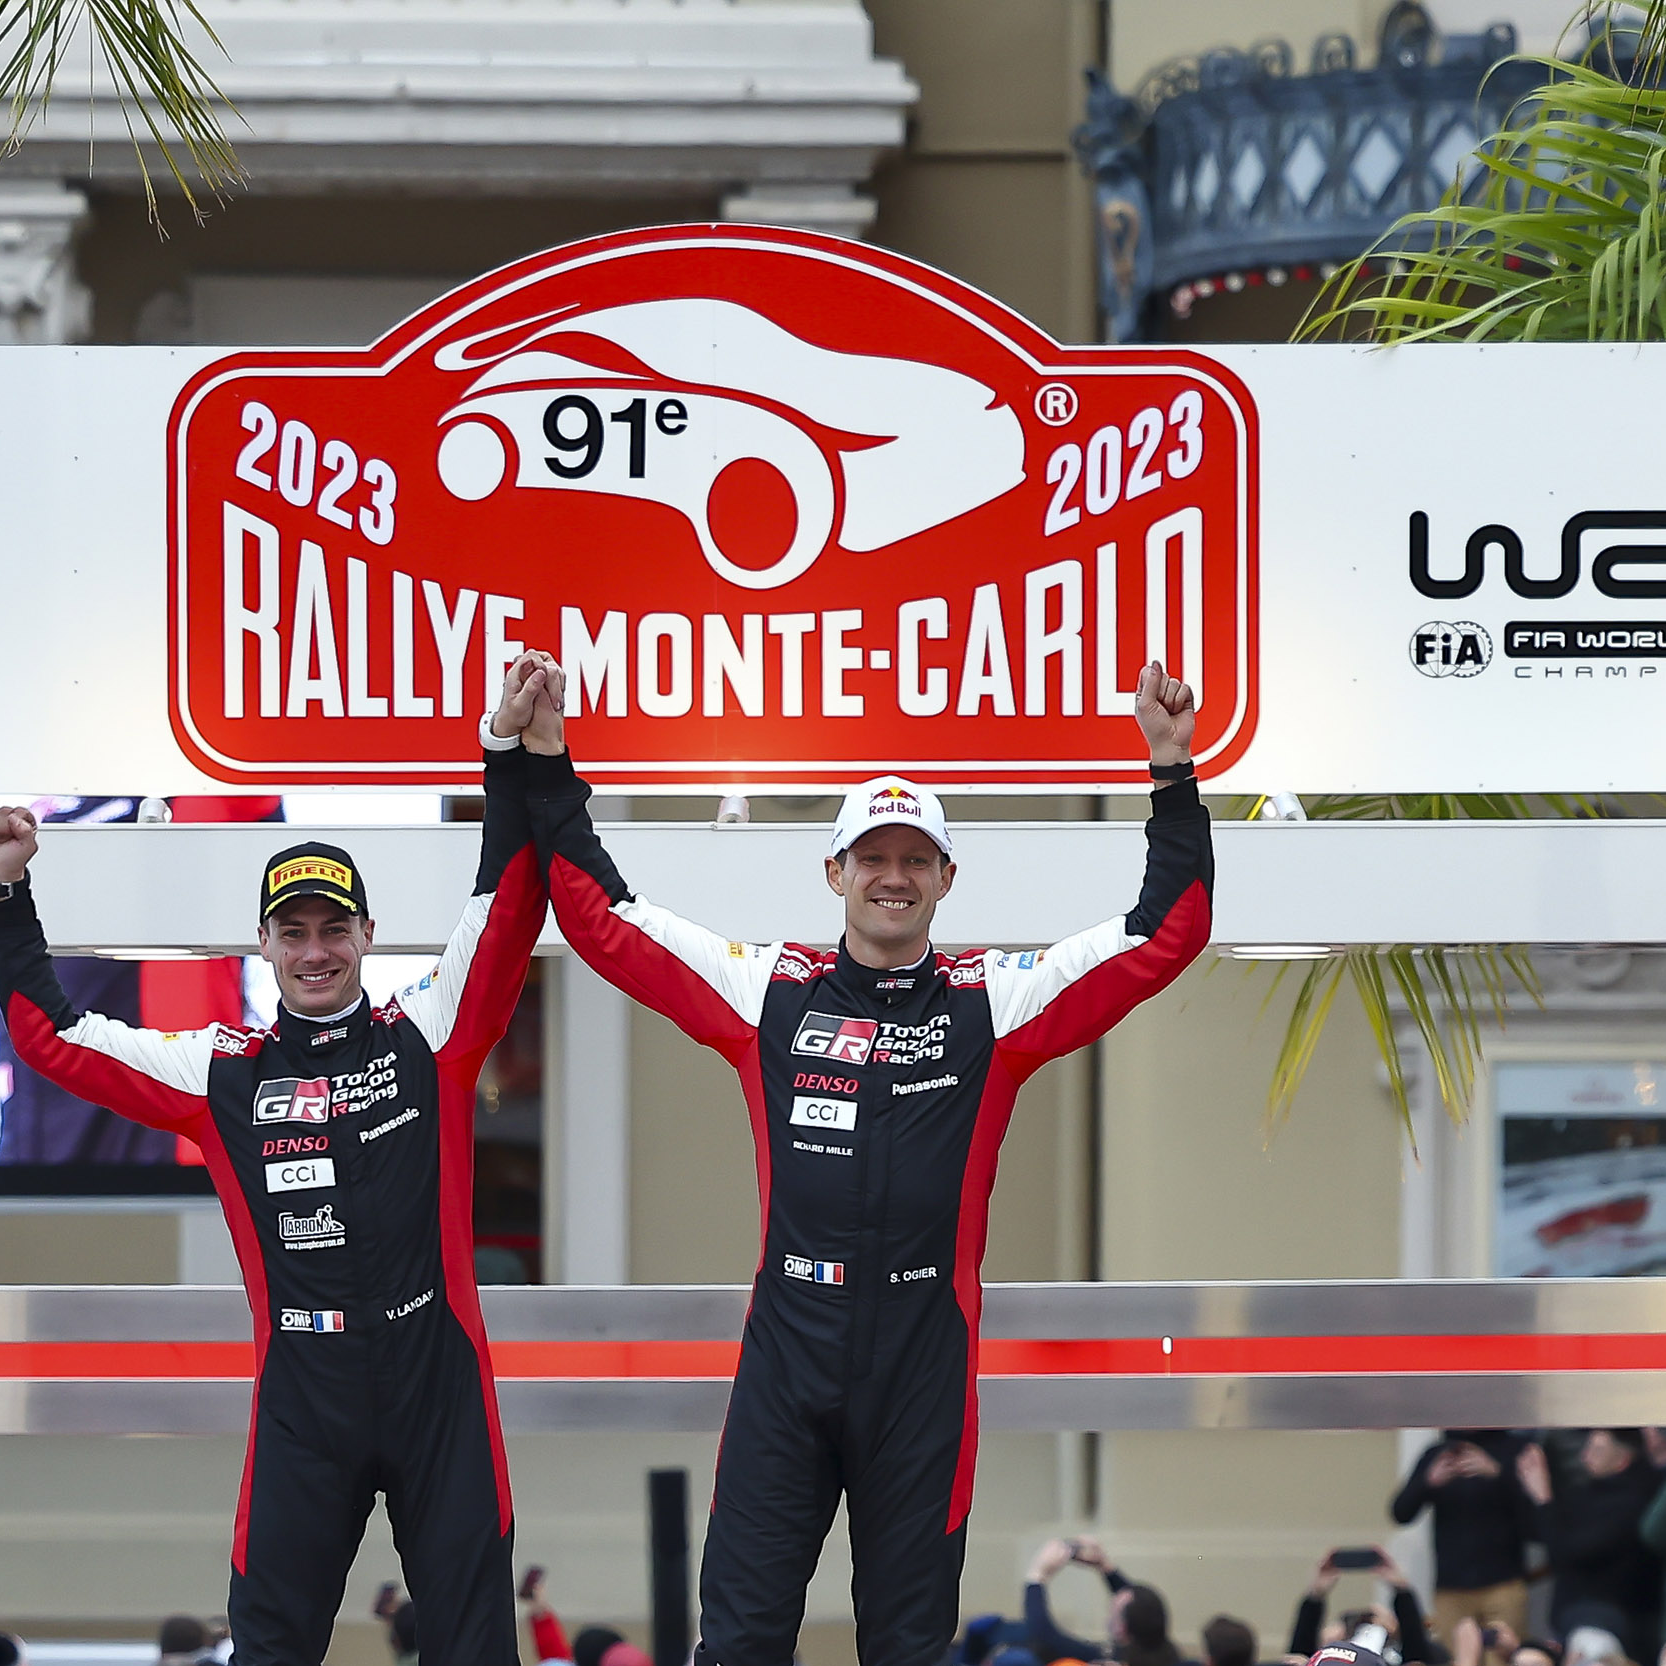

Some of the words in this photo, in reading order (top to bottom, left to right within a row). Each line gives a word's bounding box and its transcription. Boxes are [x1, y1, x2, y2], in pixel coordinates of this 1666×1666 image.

[1044, 388, 1204, 536] 2023
[234, 399, 399, 546] 2023
[1513, 630, 1567, 649] FIA
[869, 803, 895, 817] Red
[897, 803, 921, 818] Bull
[274, 860, 346, 886] PIRELLI
[796, 1029, 870, 1060] GR
[793, 1073, 860, 1093] DENSO
[892, 1074, 958, 1095] Panasonic
[258, 1095, 326, 1120] GR
[359, 1108, 419, 1143] Panasonic
[262, 1136, 329, 1156] DENSO
[826, 1145, 853, 1156] MILLE
[784, 1259, 812, 1276] OMP
[903, 1267, 937, 1281] OGIER
[281, 1313, 311, 1327] OMP
